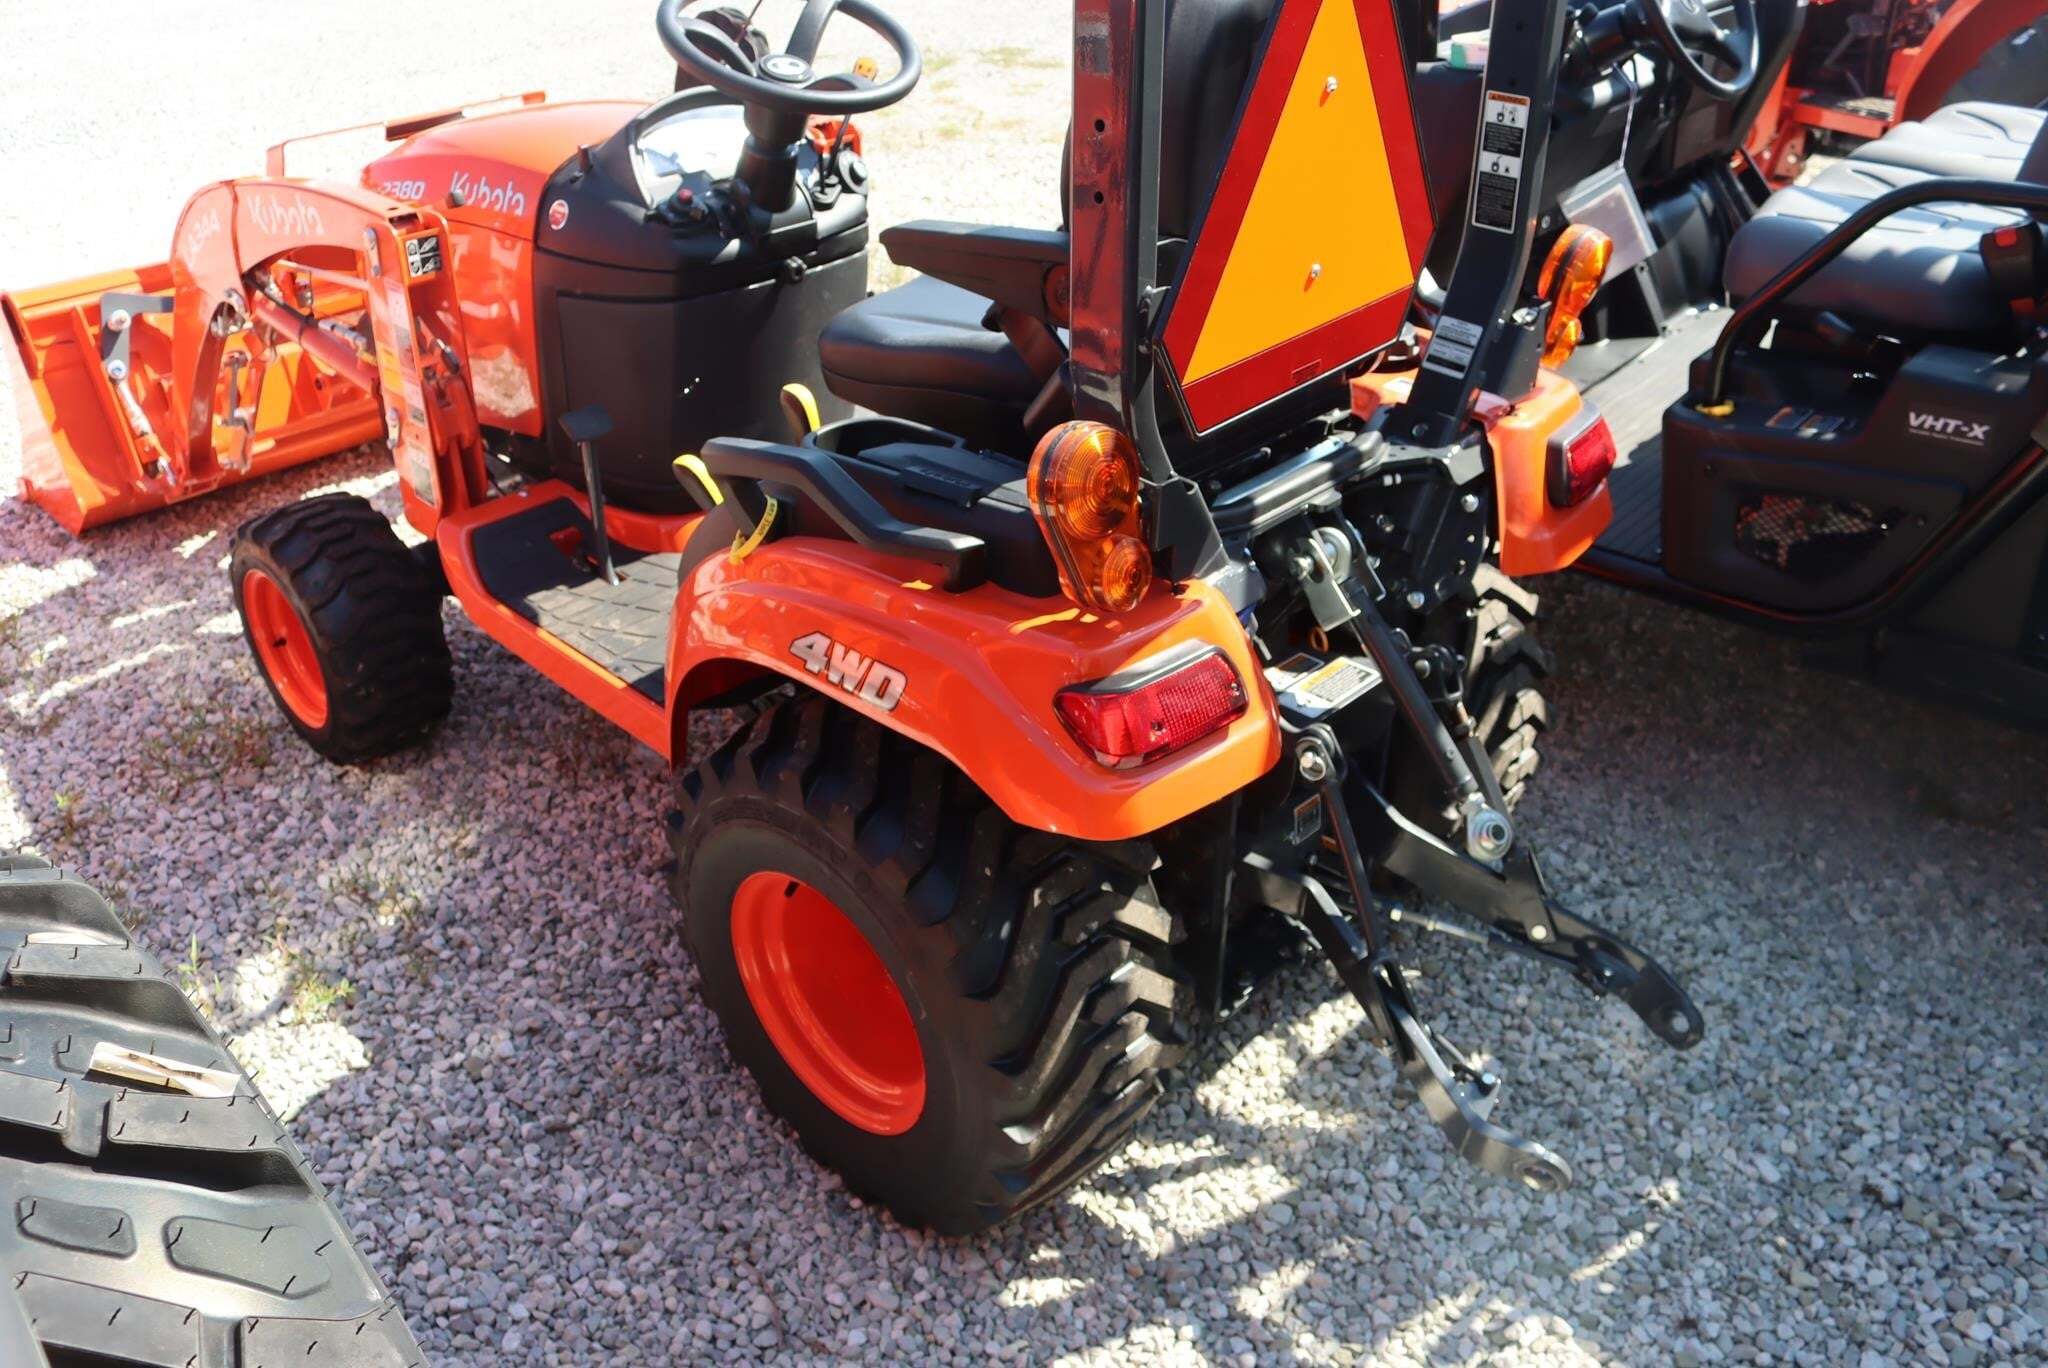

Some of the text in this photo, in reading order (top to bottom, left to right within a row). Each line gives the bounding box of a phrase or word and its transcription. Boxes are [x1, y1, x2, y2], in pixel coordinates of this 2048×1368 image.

[248, 193, 326, 236] Kubota
[450, 170, 525, 217] Kubota
[1908, 411, 1991, 440] VHT-X
[788, 630, 908, 713] 4WD
